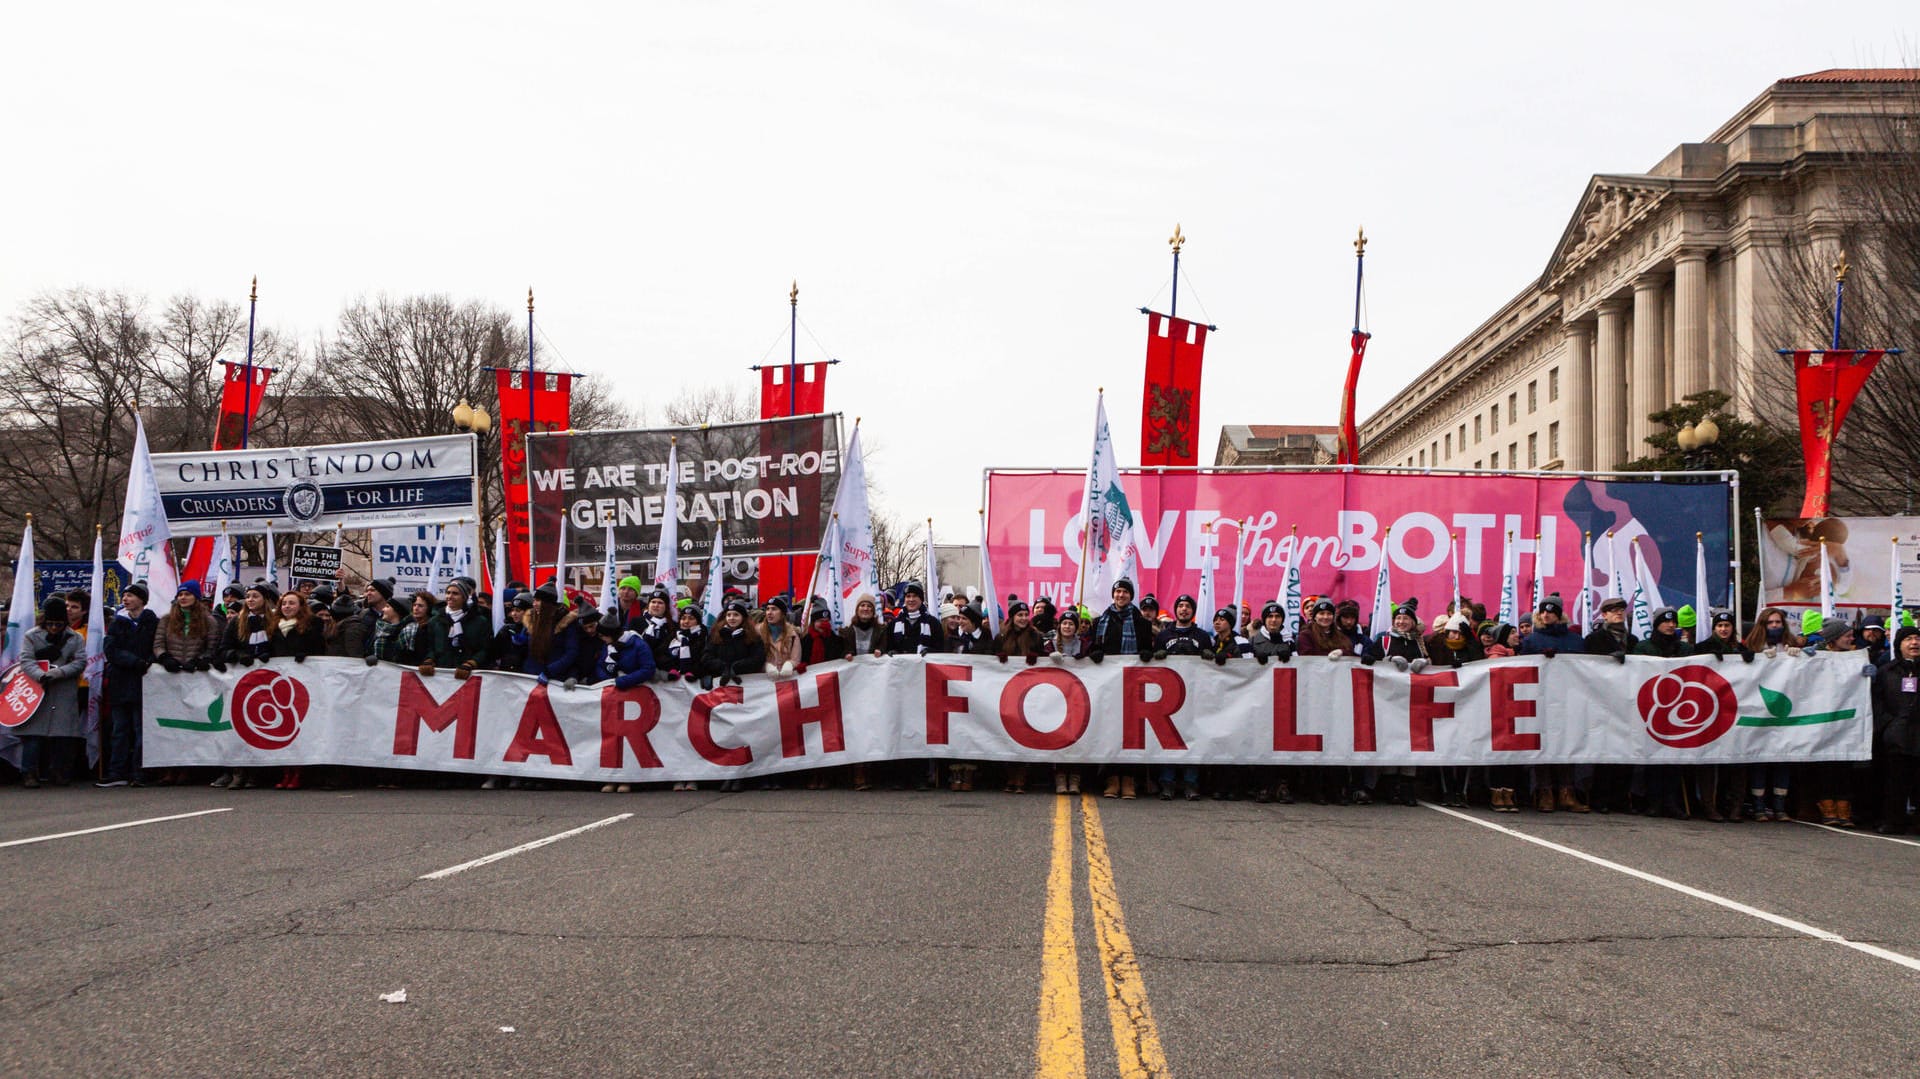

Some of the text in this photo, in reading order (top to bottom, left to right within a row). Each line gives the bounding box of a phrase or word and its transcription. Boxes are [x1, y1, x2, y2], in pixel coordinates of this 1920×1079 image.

[178, 448, 436, 483] CHRISTENDOM
[532, 449, 838, 492] WE ARE THE POST-ROE
[180, 487, 425, 515] CRUSADERS FOR LIFE
[570, 486, 800, 530] GENERATION
[321, 552, 338, 560] THE
[1211, 508, 1351, 569] them
[1337, 508, 1558, 577] BOTH
[294, 557, 340, 568] POST-ROE
[396, 566, 454, 578] FOR LFE
[4, 690, 28, 717] LOVE
[14, 675, 39, 704] BOTH
[392, 663, 1541, 769] MARCH FOR LIFE
